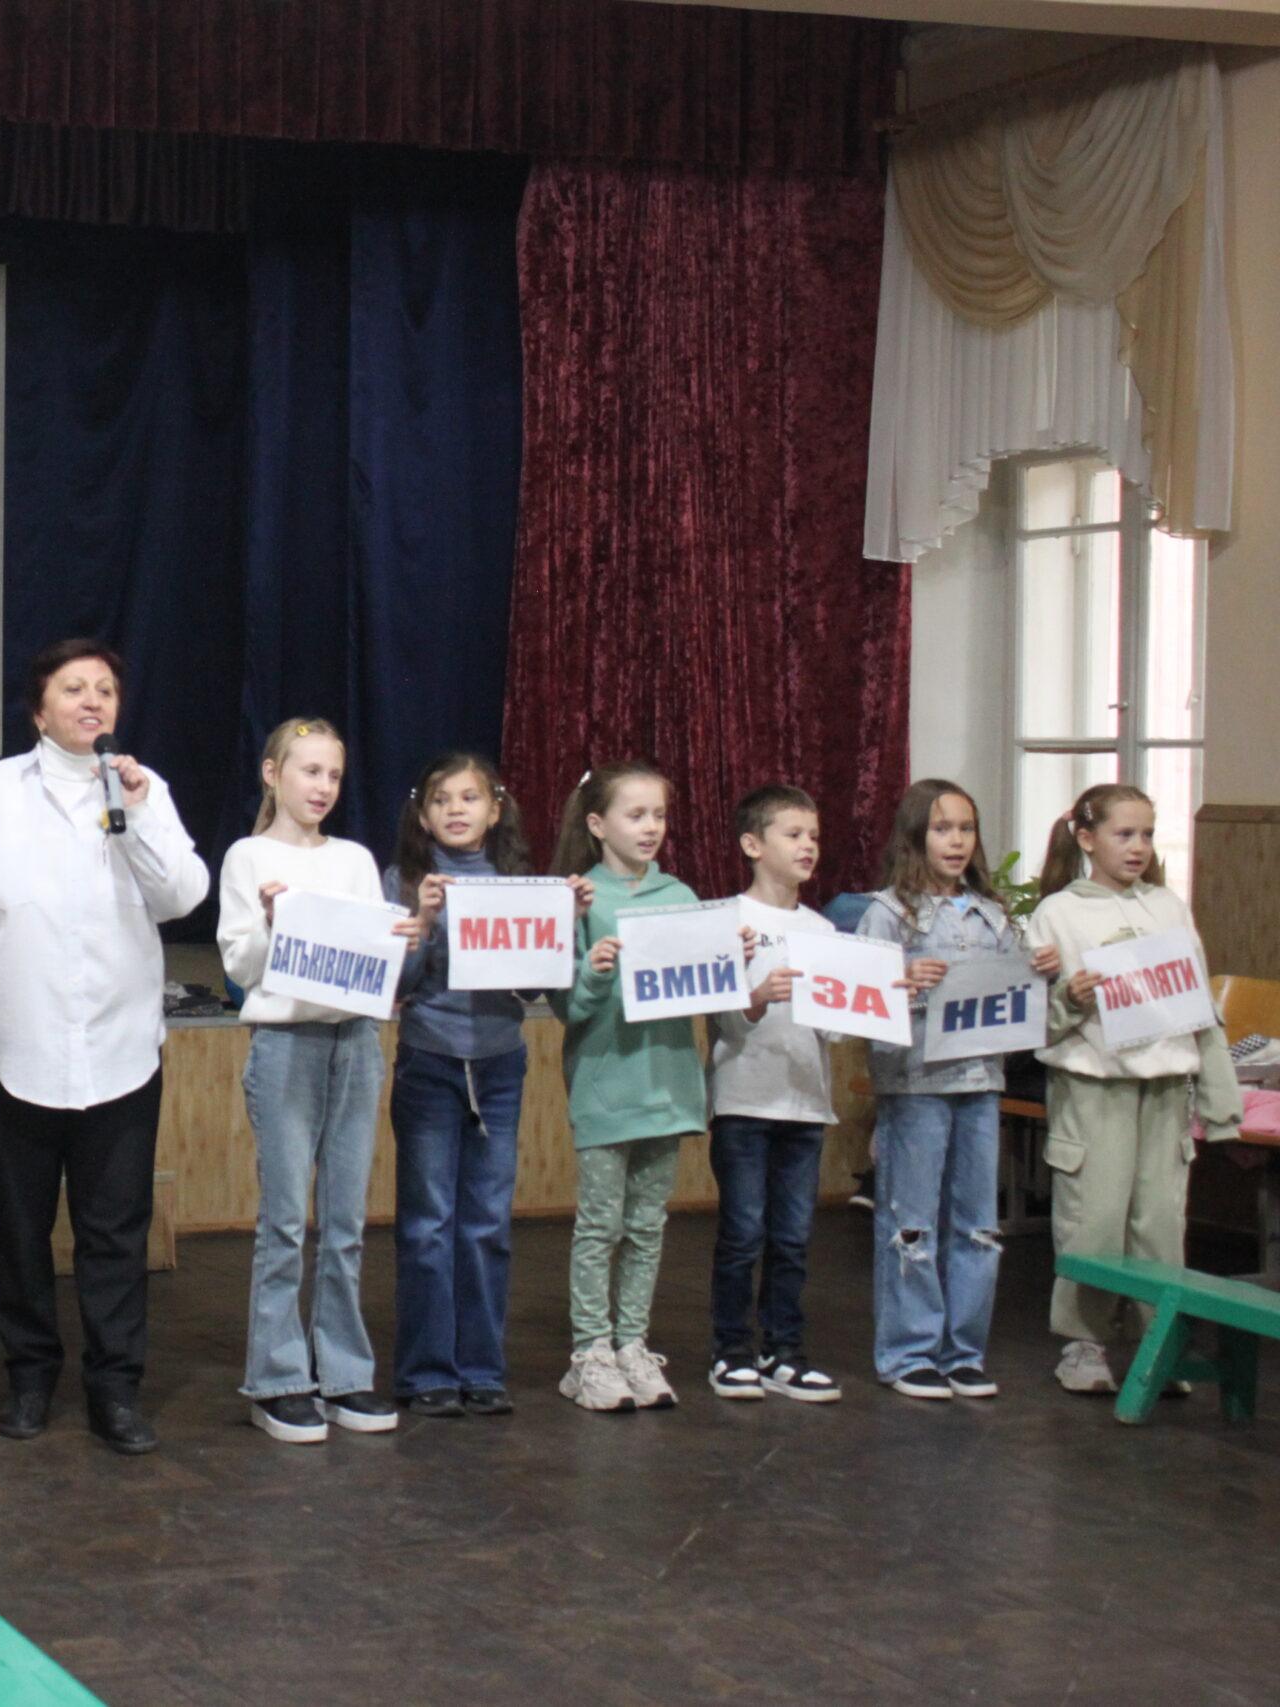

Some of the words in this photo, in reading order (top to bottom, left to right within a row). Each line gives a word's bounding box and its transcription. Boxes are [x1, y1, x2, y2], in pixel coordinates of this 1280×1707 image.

[459, 917, 565, 953] МАТИ,
[269, 933, 389, 997] БАТЬКІВЩИНА
[634, 954, 738, 1003] ВМІЙ
[1103, 957, 1198, 1011] ПОСТОЯТИ
[812, 975, 891, 1020] ЗА
[942, 983, 1032, 1033] НЕЇ
